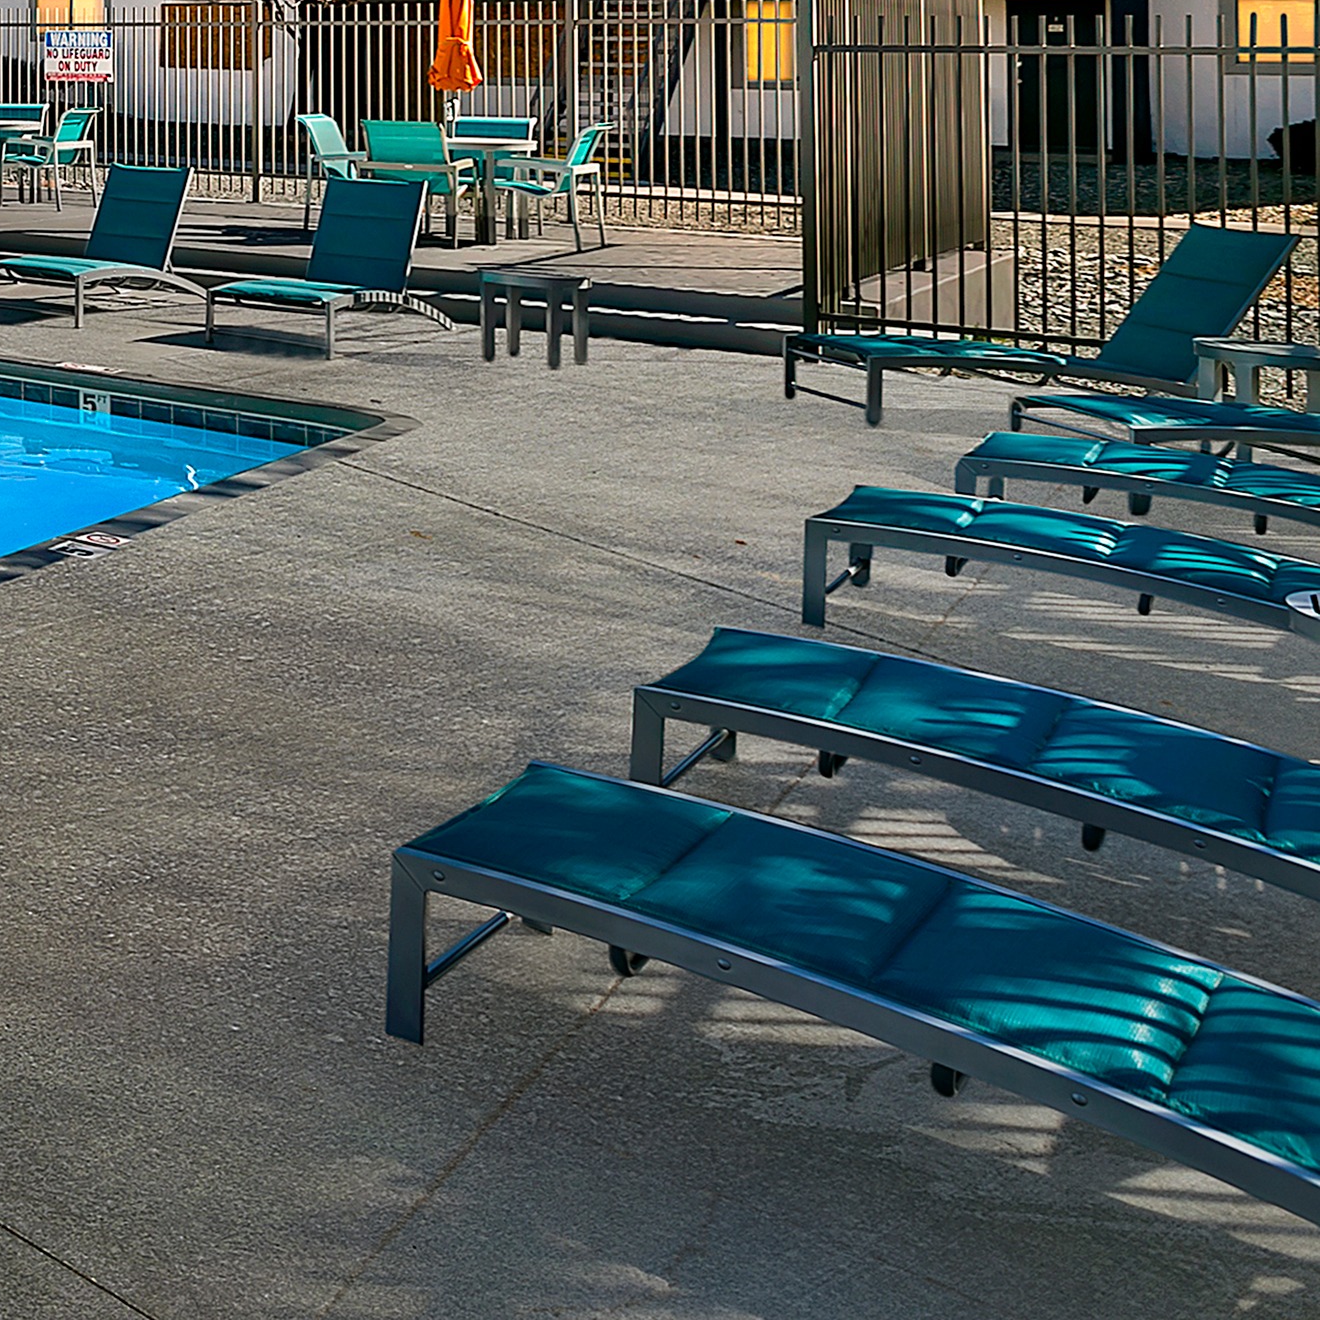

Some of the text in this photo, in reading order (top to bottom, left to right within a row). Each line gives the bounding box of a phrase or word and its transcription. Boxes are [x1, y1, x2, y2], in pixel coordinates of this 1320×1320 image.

[50, 33, 108, 47] WARNING
[46, 48, 111, 60] NO LIFEGUARD
[58, 60, 98, 72] ON DUTY
[82, 392, 97, 412] 5
[56, 545, 94, 557] 5
